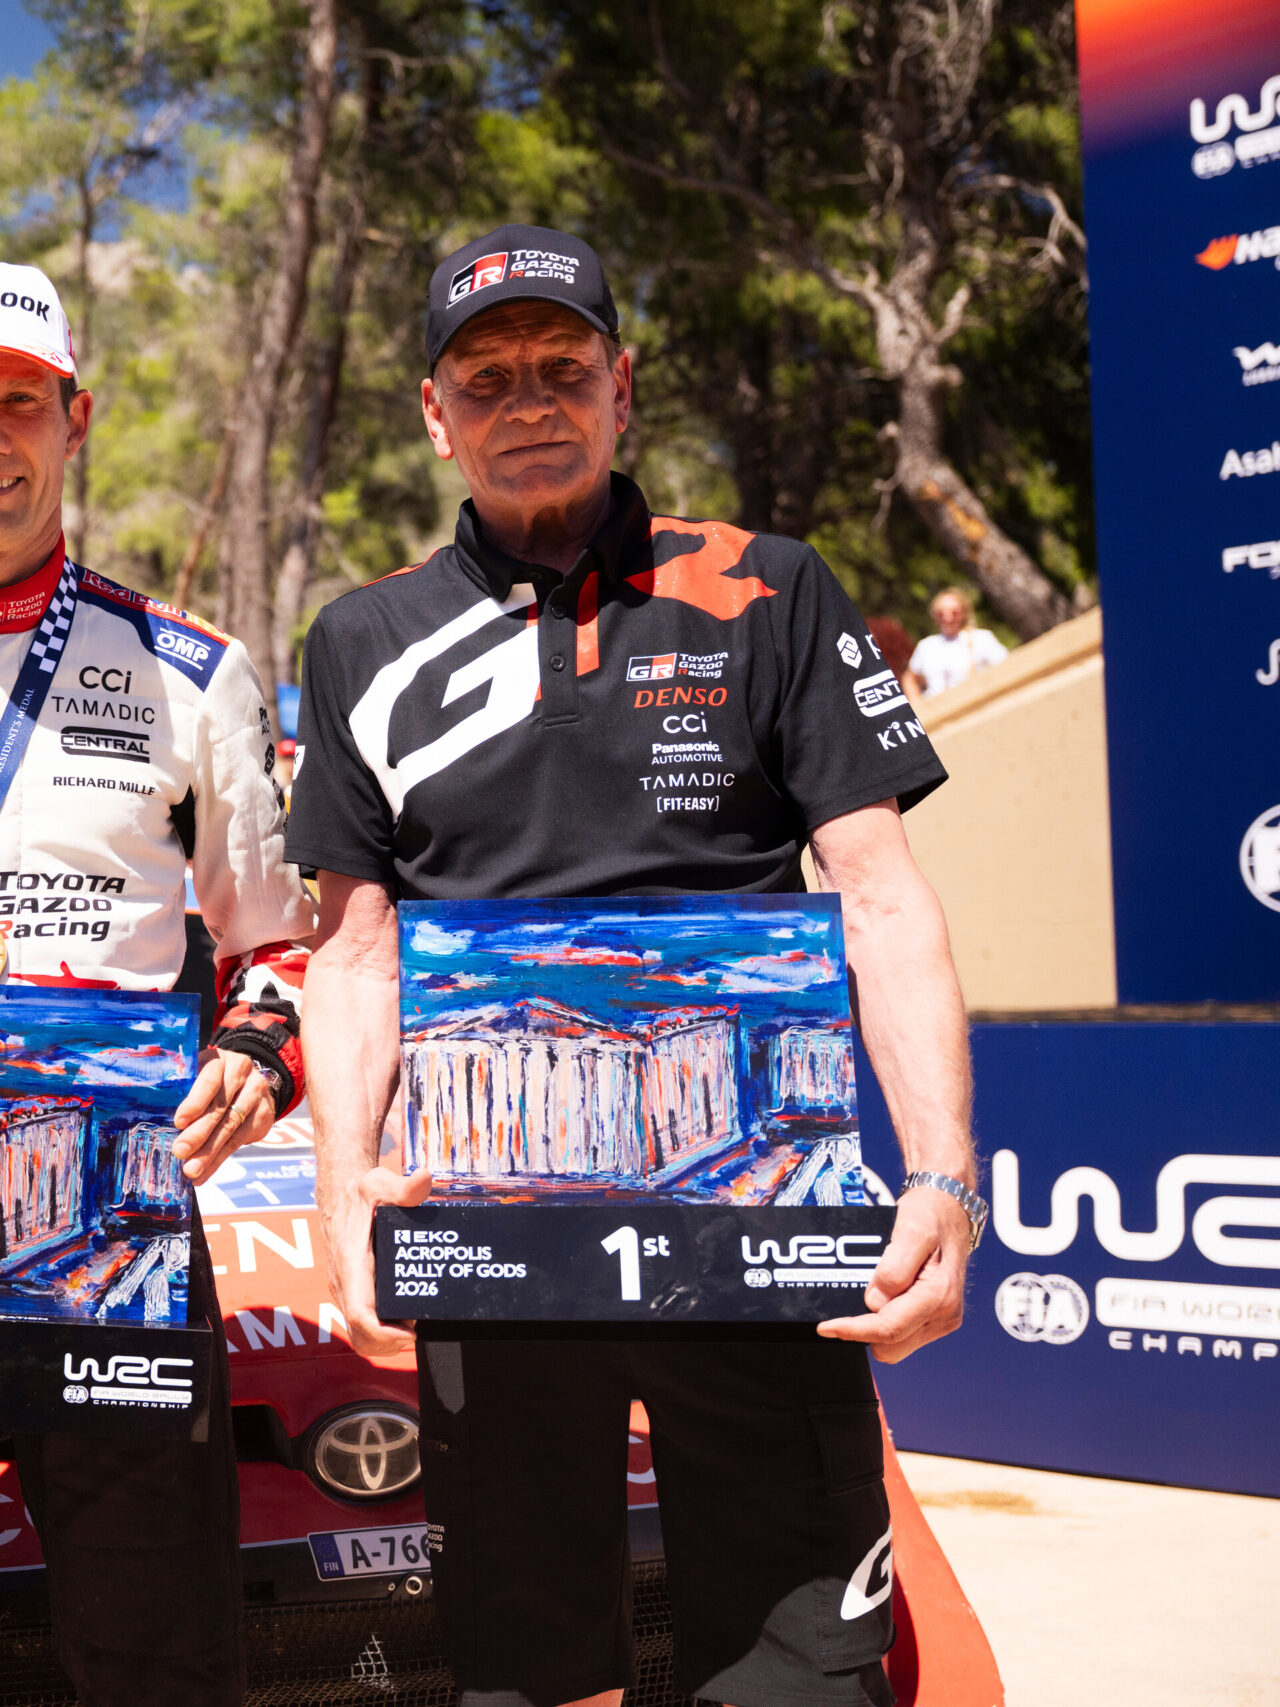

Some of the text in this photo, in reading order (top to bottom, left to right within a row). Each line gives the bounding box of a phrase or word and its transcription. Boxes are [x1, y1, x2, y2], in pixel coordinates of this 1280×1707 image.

[1190, 74, 1280, 144] W
[511, 249, 580, 268] TOYOTA
[511, 260, 576, 274] GAZOO
[449, 266, 502, 303] GR
[509, 270, 575, 284] Racing
[7, 600, 43, 614] GAZOO
[8, 591, 46, 608] TOYOTA
[7, 608, 41, 620] Racing
[157, 632, 210, 663] OMP
[679, 652, 729, 662] TOYOTA
[630, 664, 673, 679] GR
[677, 668, 722, 679] Racing
[678, 661, 724, 670] GAZOO
[16, 688, 35, 720] MEDAL
[633, 686, 728, 709] DENSO
[51, 696, 156, 725] TAMADIC
[60, 733, 150, 755] CENTRAL
[651, 741, 720, 754] Panasonic
[651, 754, 724, 765] AUTOMOTIVE
[52, 776, 156, 796] RICHARD MILLE
[639, 773, 736, 790] TAMADIC
[413, 1231, 459, 1244] EKO
[395, 1246, 492, 1261] ACROPOLIS
[741, 1235, 883, 1265] WRC
[394, 1263, 527, 1278] RALLY OF GODS
[600, 1225, 670, 1301] 1st
[395, 1281, 439, 1297] 2026
[1111, 1293, 1280, 1322] FIA WOR
[64, 1352, 194, 1387] WRC
[93, 1399, 190, 1410] CHAMPIONSHIP
[323, 1562, 339, 1572] FIN
